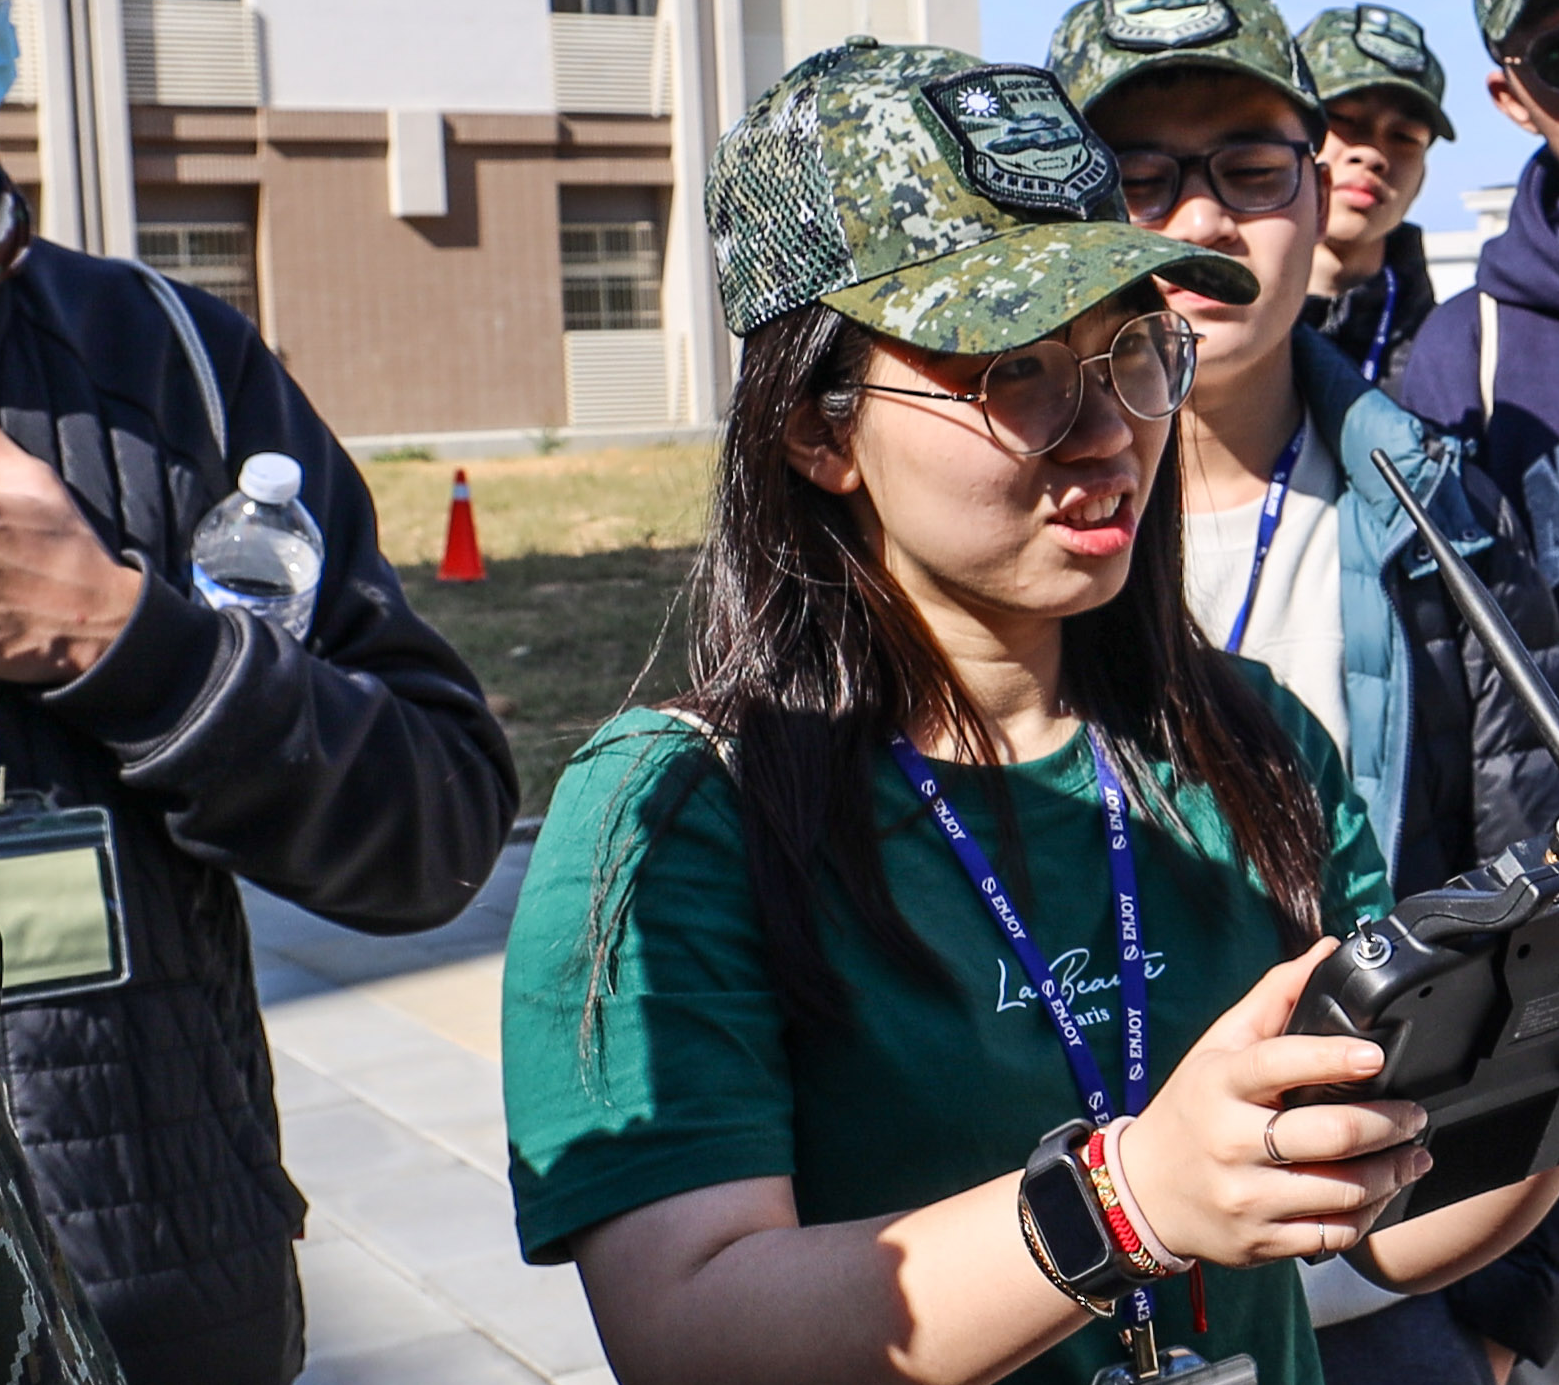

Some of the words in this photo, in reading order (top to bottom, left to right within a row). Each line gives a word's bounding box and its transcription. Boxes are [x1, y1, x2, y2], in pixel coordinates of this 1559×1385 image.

[931, 796, 967, 841] ENJOY
[1103, 785, 1125, 832] ENJOY
[991, 894, 1027, 940] ENJOY
[1119, 892, 1138, 941] ENJOY
[1050, 998, 1083, 1047] ENJOY
[1074, 1005, 1111, 1027] aris
[1126, 1007, 1143, 1059] ENJOY
